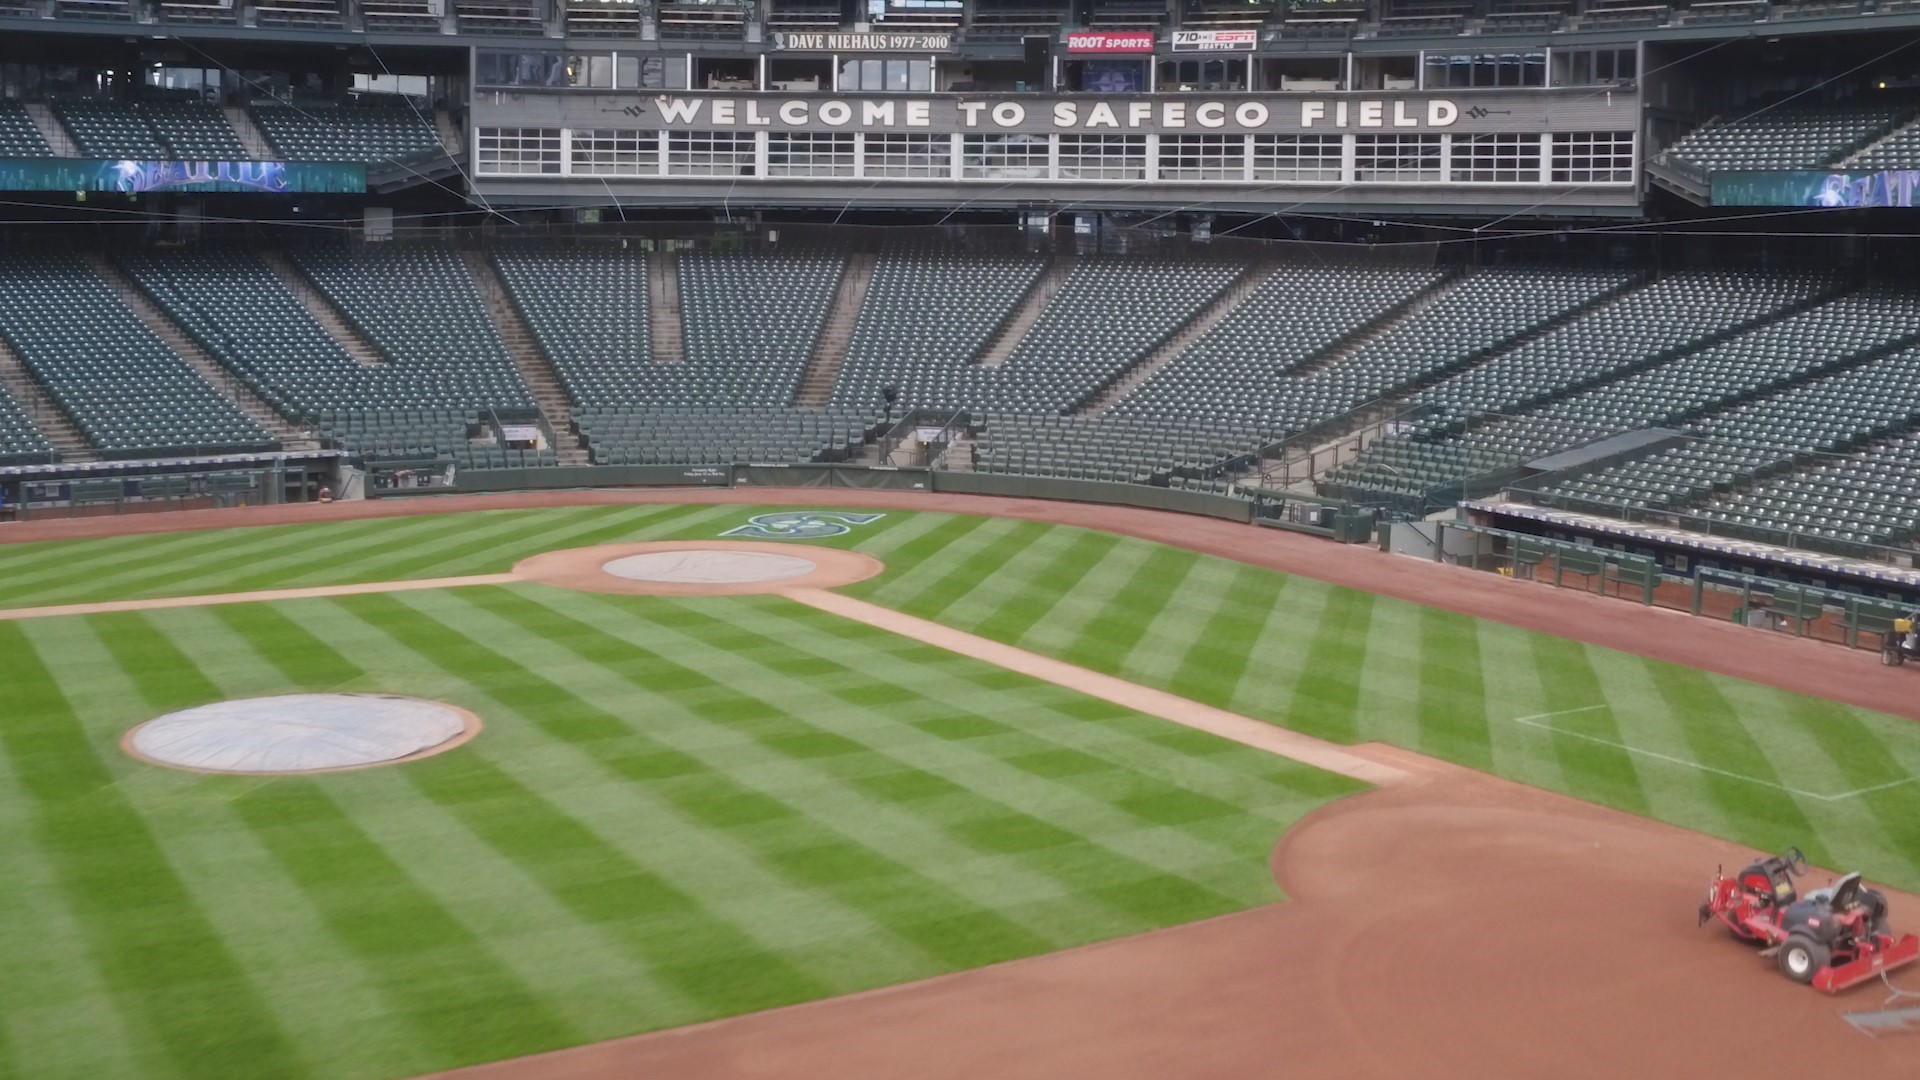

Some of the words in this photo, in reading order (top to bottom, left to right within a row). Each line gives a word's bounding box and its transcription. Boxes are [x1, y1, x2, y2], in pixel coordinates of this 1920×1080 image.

[788, 34, 824, 49] DAVE
[828, 34, 887, 49] NIEHAUS
[890, 35, 948, 49] 1977-2010
[1068, 36, 1105, 48] ROOT
[1176, 32, 1199, 42] 710
[1215, 31, 1256, 42] ESPN
[654, 99, 931, 126] WELCOME
[957, 101, 1026, 127] TO
[1052, 101, 1270, 128] SAFECO
[1301, 100, 1459, 127] FIELD
